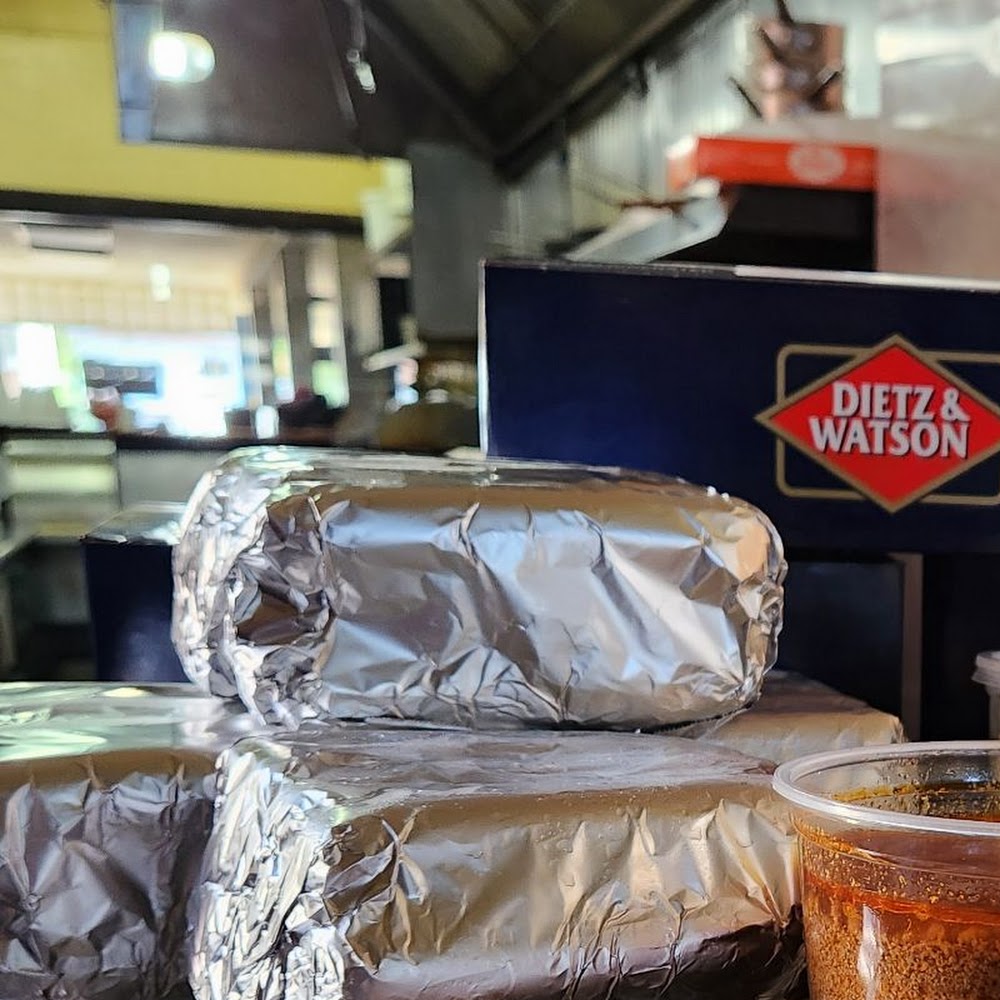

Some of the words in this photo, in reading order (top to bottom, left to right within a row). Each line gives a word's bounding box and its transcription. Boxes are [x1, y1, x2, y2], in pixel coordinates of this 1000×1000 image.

[832, 380, 935, 420] DIETZ
[940, 388, 970, 421] &
[808, 415, 970, 458] WATSON
